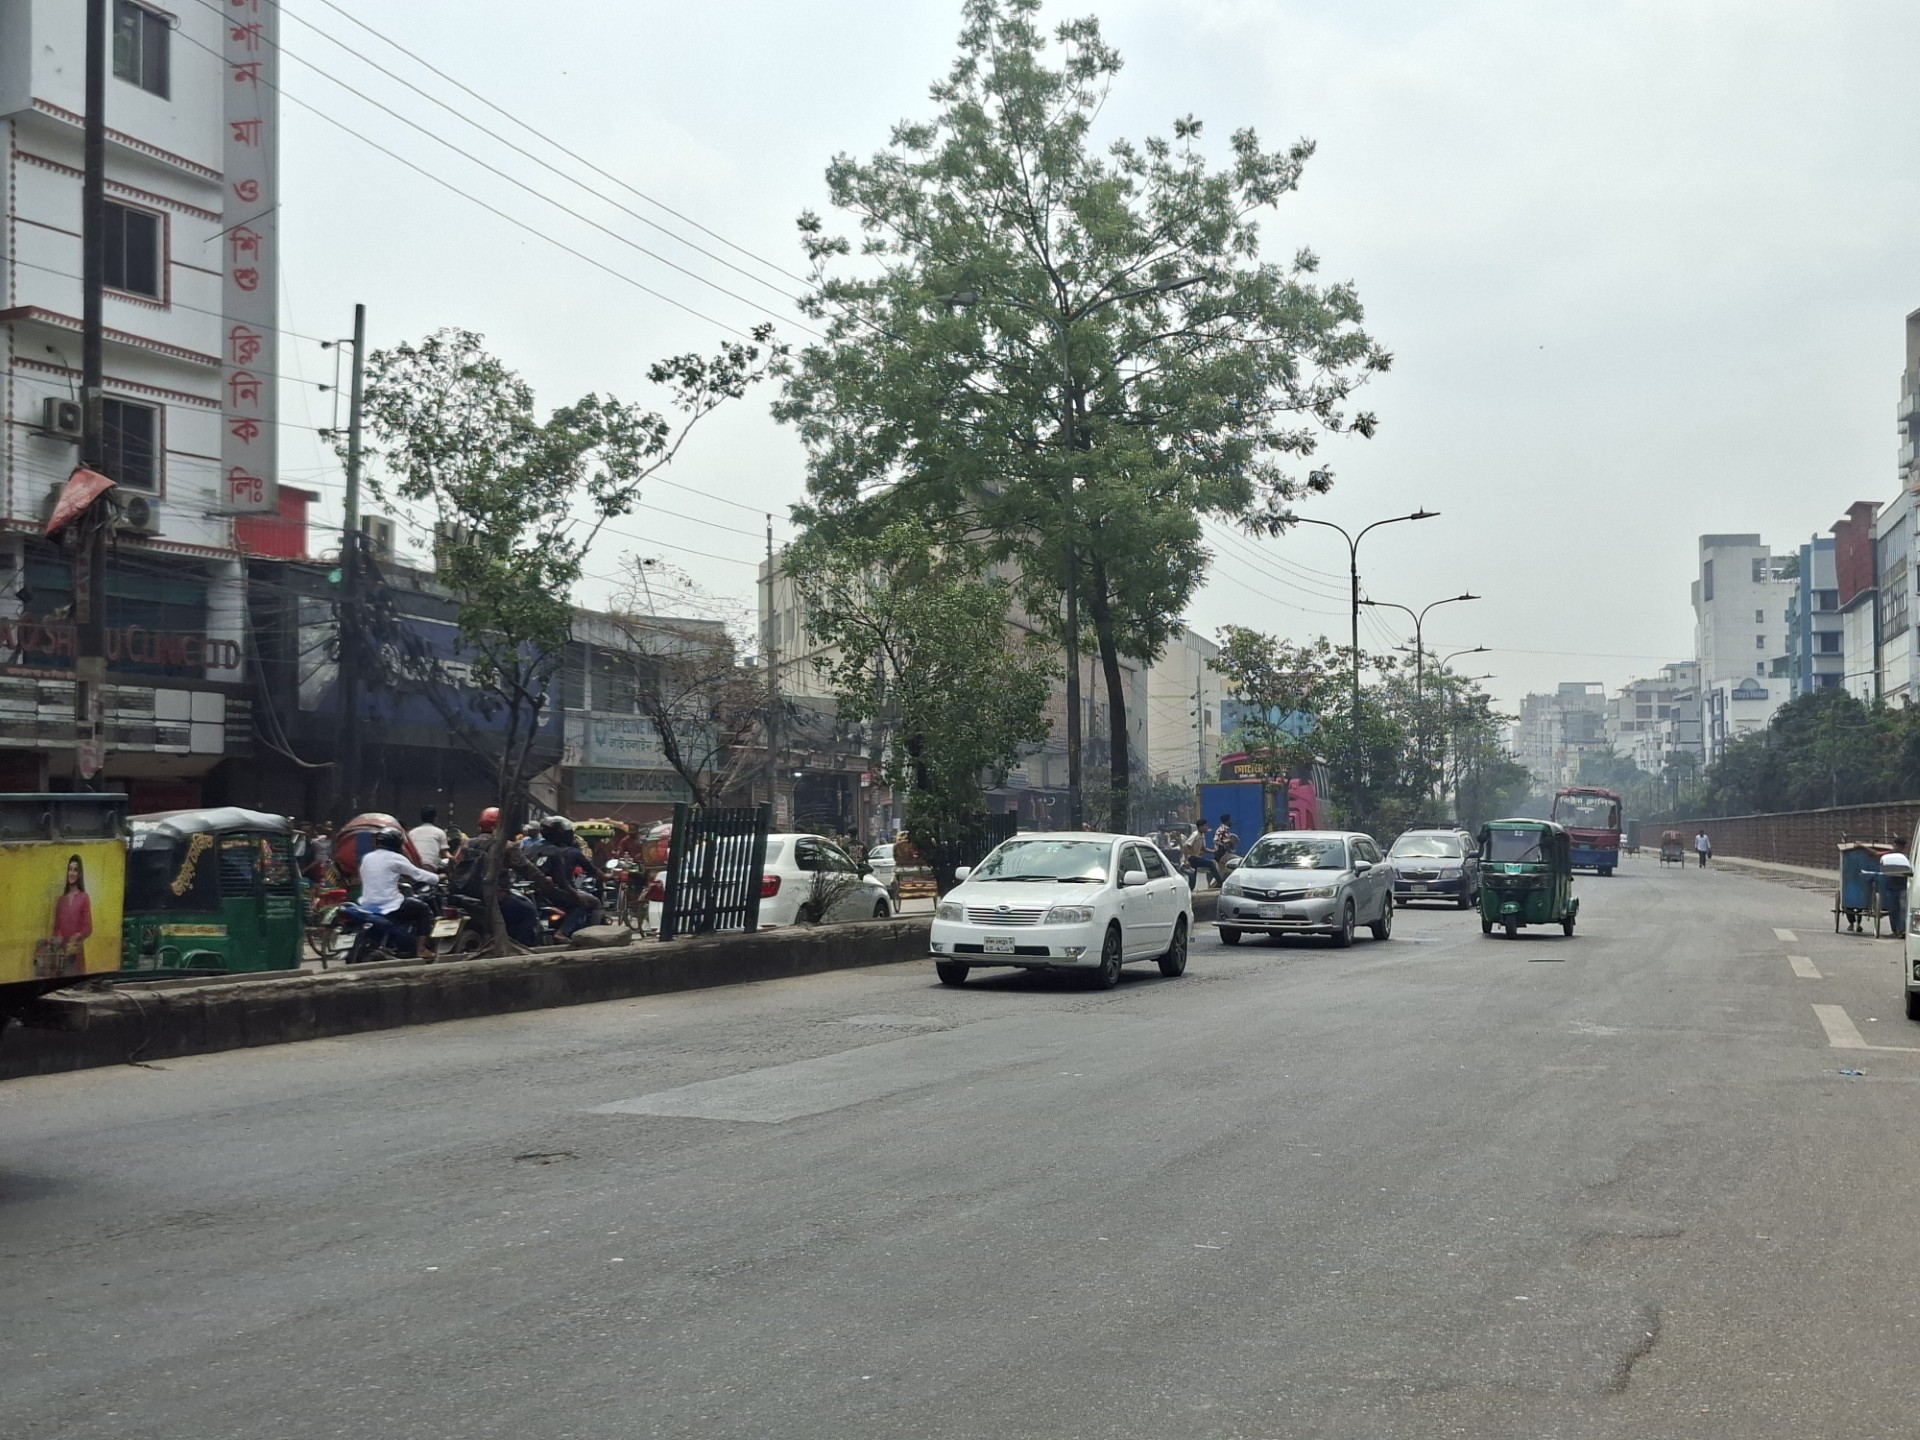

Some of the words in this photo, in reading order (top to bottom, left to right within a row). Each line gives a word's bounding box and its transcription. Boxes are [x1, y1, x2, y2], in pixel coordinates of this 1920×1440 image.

[230, 117, 263, 147] মা
[233, 178, 260, 203] ও
[228, 226, 264, 292] শিশু
[228, 325, 264, 446] ক্লিনিক
[126, 624, 200, 666] CLINIC
[202, 638, 240, 670] LTD
